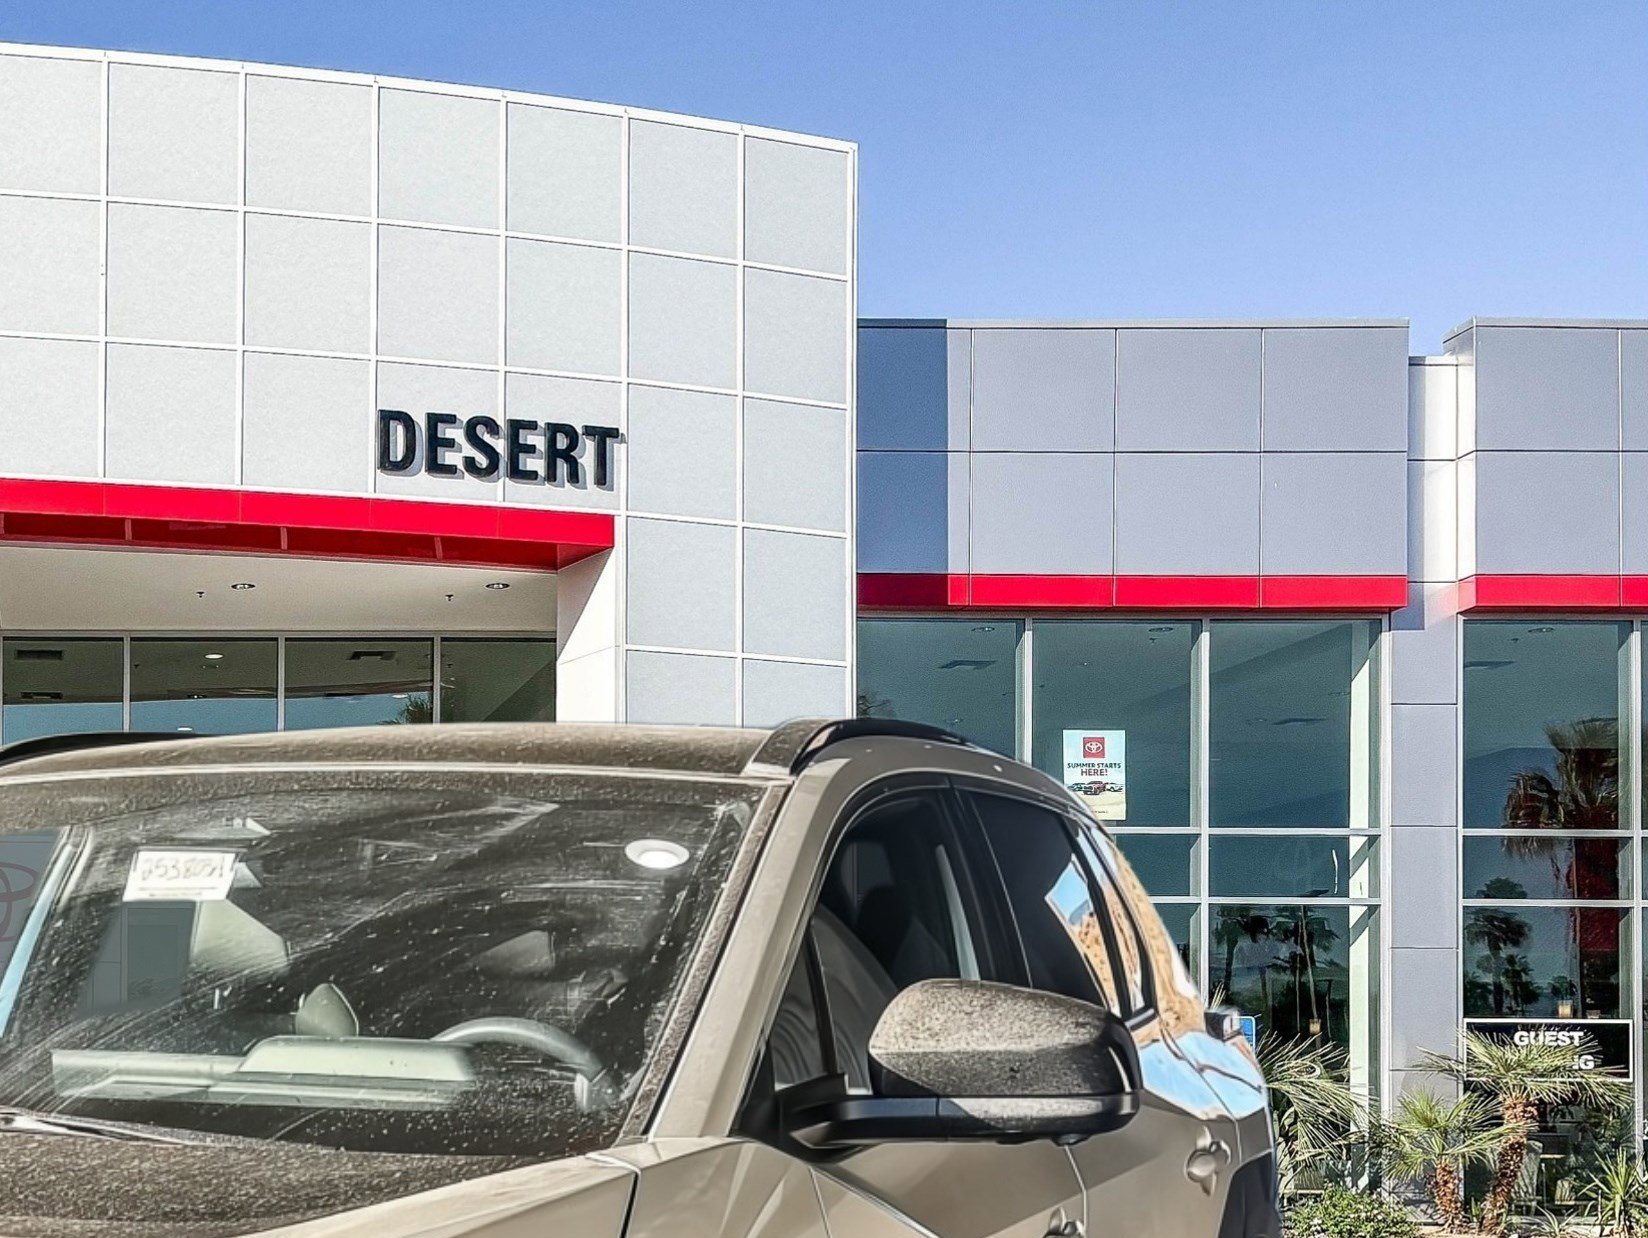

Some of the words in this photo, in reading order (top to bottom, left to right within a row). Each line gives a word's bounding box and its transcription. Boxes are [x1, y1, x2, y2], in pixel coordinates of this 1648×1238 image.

[376, 409, 620, 487] DESERT
[1080, 768, 1108, 776] HERE!
[1513, 1031, 1584, 1047] GUEST
